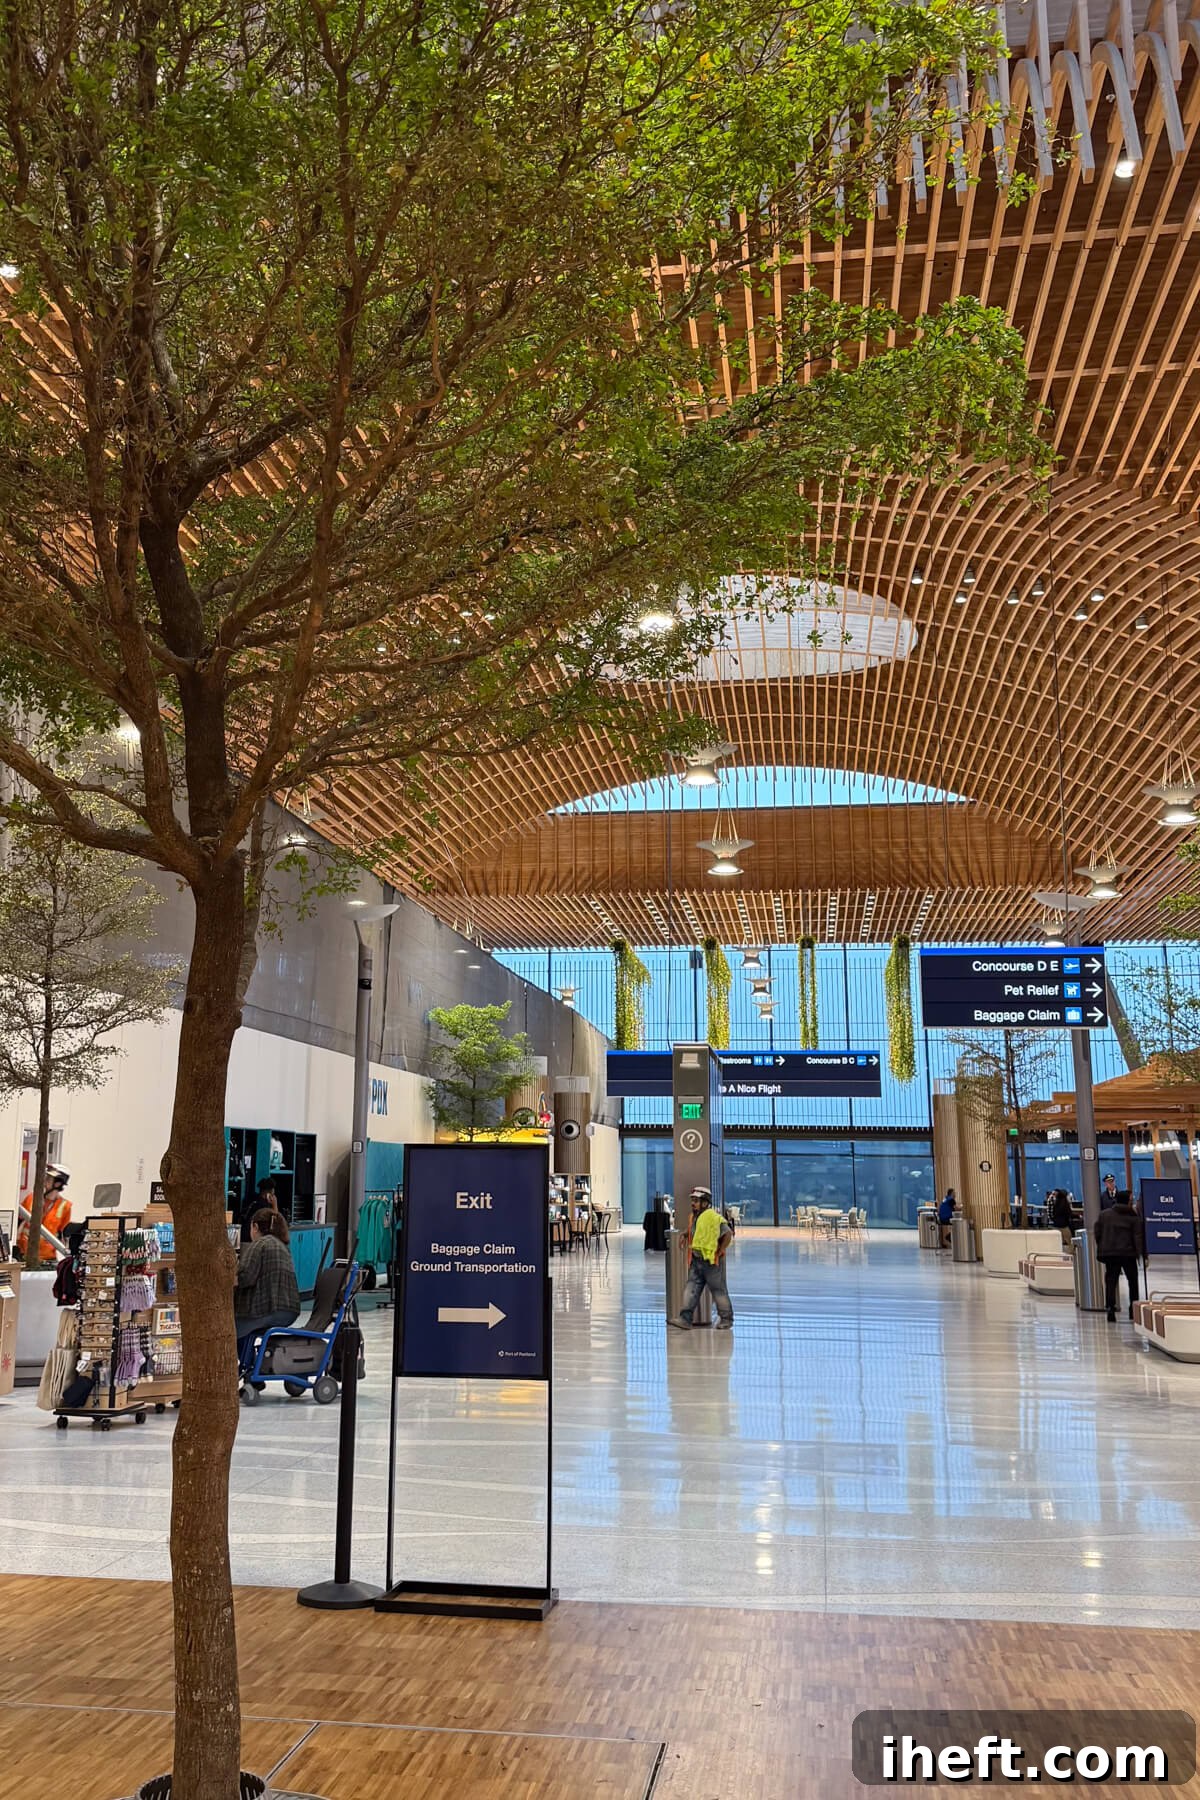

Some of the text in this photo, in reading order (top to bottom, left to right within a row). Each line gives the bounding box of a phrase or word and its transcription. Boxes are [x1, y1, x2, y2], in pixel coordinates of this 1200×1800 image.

[972, 960, 1059, 971] Concourse D E
[1004, 984, 1060, 996] Pet Relief
[974, 1009, 1060, 1023] Baggage Claim
[806, 1056, 841, 1065] Concourse
[849, 1056, 855, 1064] C
[728, 1084, 736, 1093] A
[737, 1083, 757, 1093] Nice
[758, 1083, 782, 1095] Flight
[371, 1078, 388, 1116] PDX
[682, 1103, 702, 1119] EXIT
[456, 1191, 493, 1209] Exit
[1160, 1195, 1174, 1203] Exit
[431, 1242, 516, 1256] Baggage Claim
[410, 1260, 536, 1274] Ground Transportation
